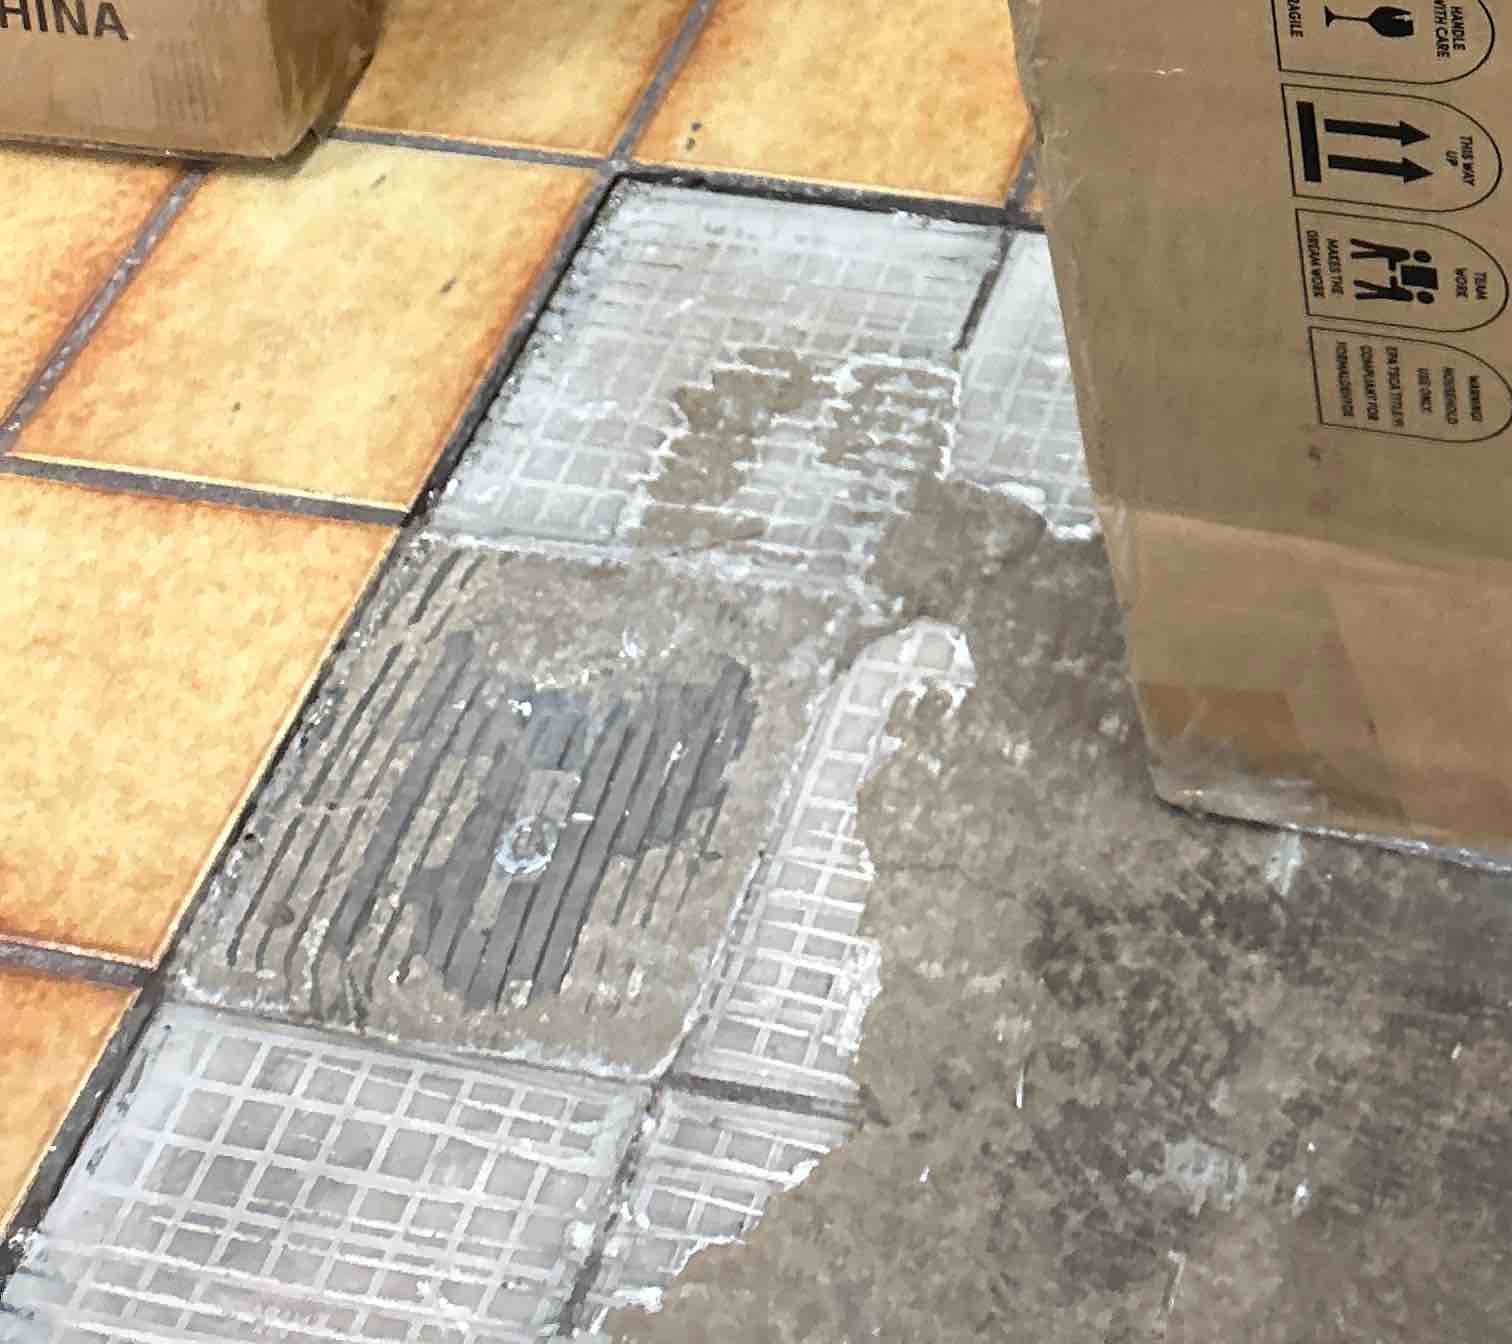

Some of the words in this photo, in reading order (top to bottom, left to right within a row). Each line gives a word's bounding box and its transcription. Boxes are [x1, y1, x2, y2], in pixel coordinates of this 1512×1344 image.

[1451, 6, 1466, 50] HANDLE
[1436, 27, 1450, 58] CARE
[1445, 150, 1457, 166] UP
[1460, 136, 1473, 160] THIS
[1462, 162, 1475, 186] WAY
[1306, 231, 1321, 266] DREAM
[1326, 239, 1341, 273] MAKES
[1311, 269, 1324, 297] WORK
[1331, 276, 1344, 295] THE
[1454, 268, 1467, 298] WORK
[1474, 272, 1487, 300] TEAM
